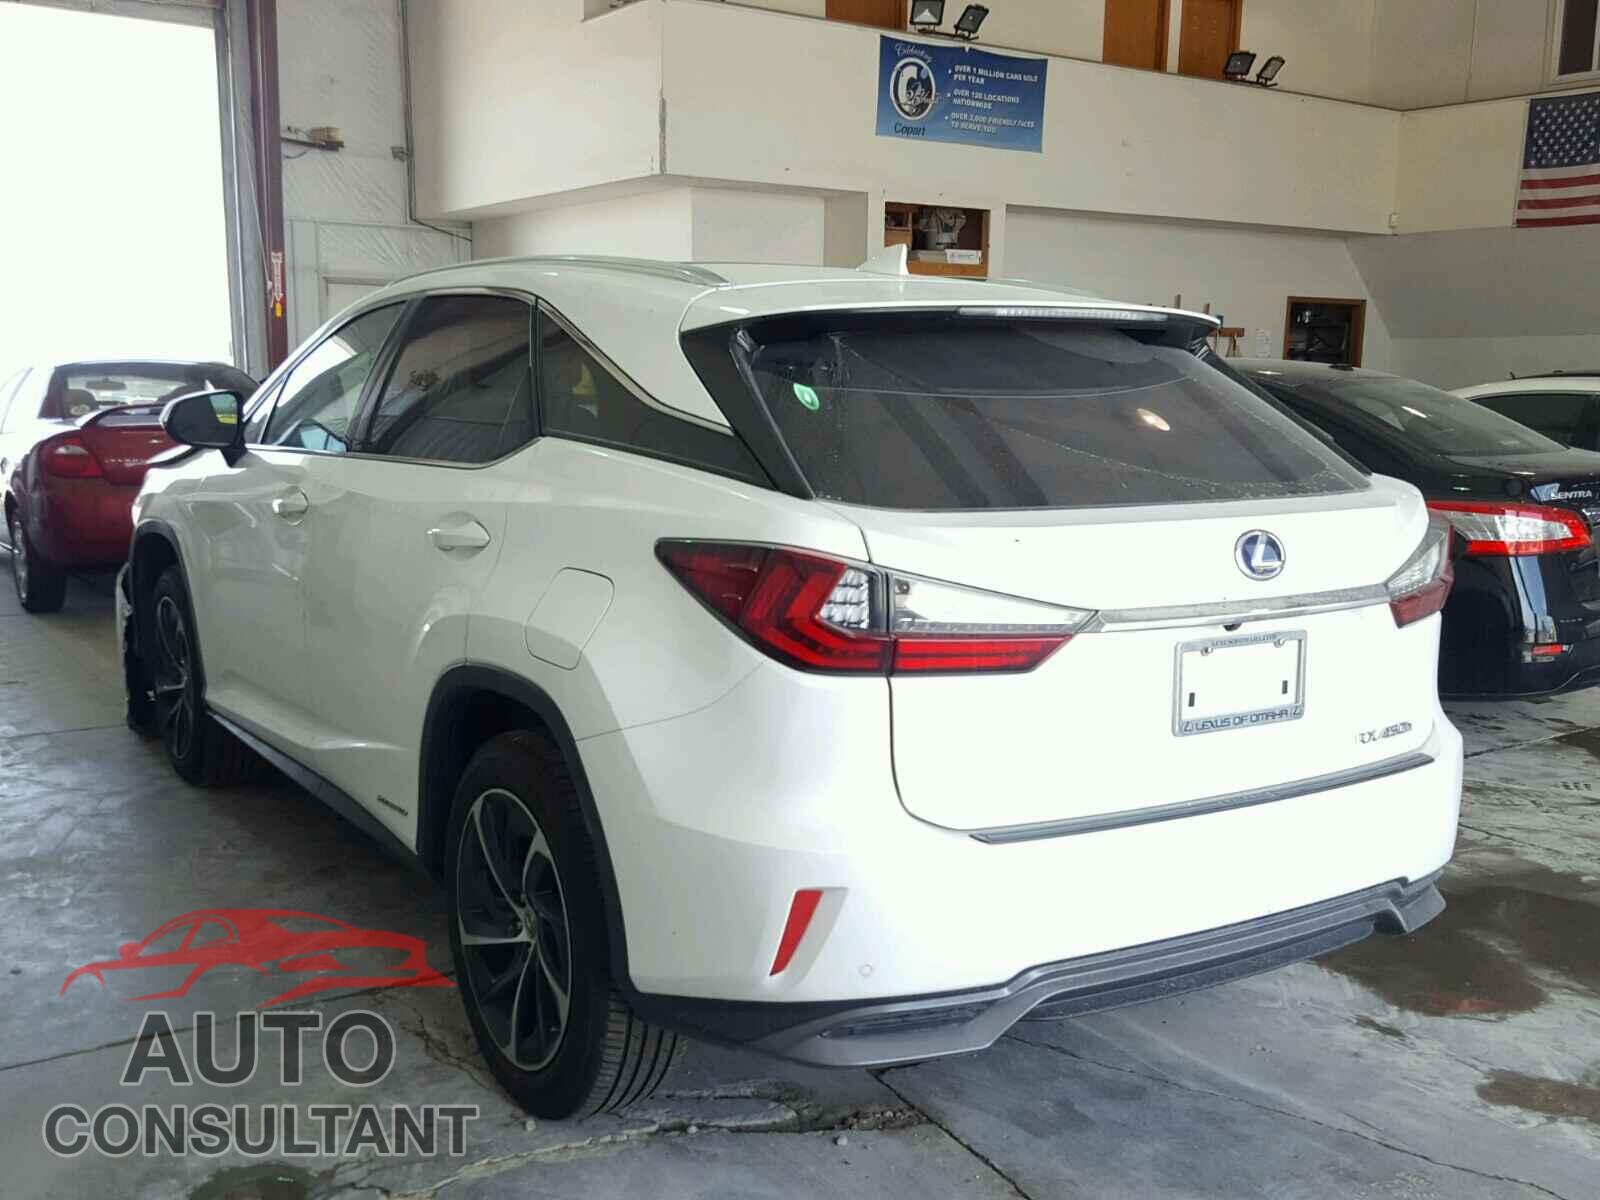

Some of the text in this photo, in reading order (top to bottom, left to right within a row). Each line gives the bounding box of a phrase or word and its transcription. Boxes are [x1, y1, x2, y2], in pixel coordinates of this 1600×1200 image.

[953, 73, 985, 85] PER YEAR
[954, 64, 971, 73] OVER
[978, 68, 1005, 79] MILLION
[1006, 72, 1022, 81] CARS
[953, 88, 970, 97] OVER
[983, 93, 1020, 104] LOCATIONS
[953, 98, 993, 109] NATIONWIDE
[951, 111, 968, 121] OVER
[894, 122, 926, 137] Copart
[951, 120, 960, 129] TO
[983, 125, 997, 134] YOU
[1551, 490, 1592, 499] SENTRA
[1195, 717, 1231, 731] LEXUS
[1232, 715, 1249, 726] OF
[1249, 709, 1288, 723] OMAHA
